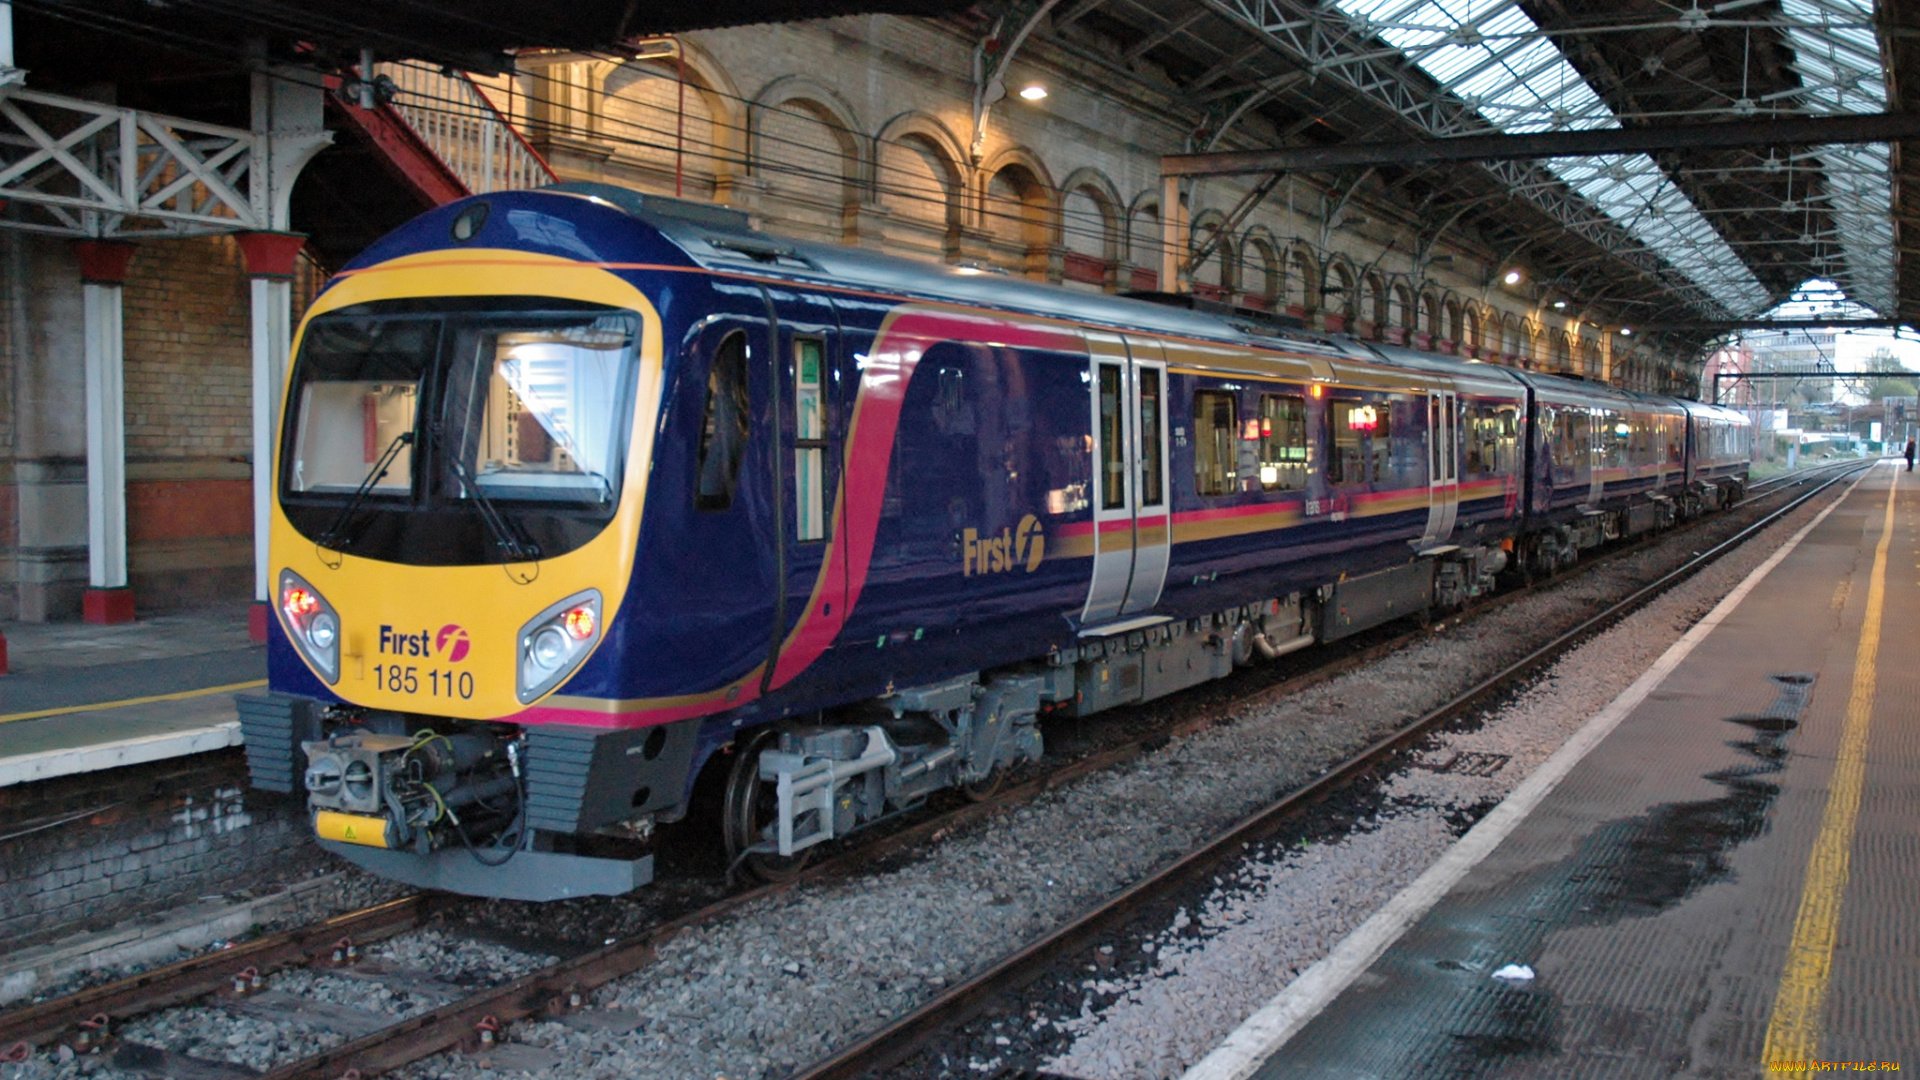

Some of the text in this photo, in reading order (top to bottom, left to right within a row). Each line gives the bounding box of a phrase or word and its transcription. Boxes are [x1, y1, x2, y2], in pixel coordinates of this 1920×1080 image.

[963, 527, 1012, 577] First
[379, 624, 430, 657] First
[373, 663, 474, 700] 185 110
